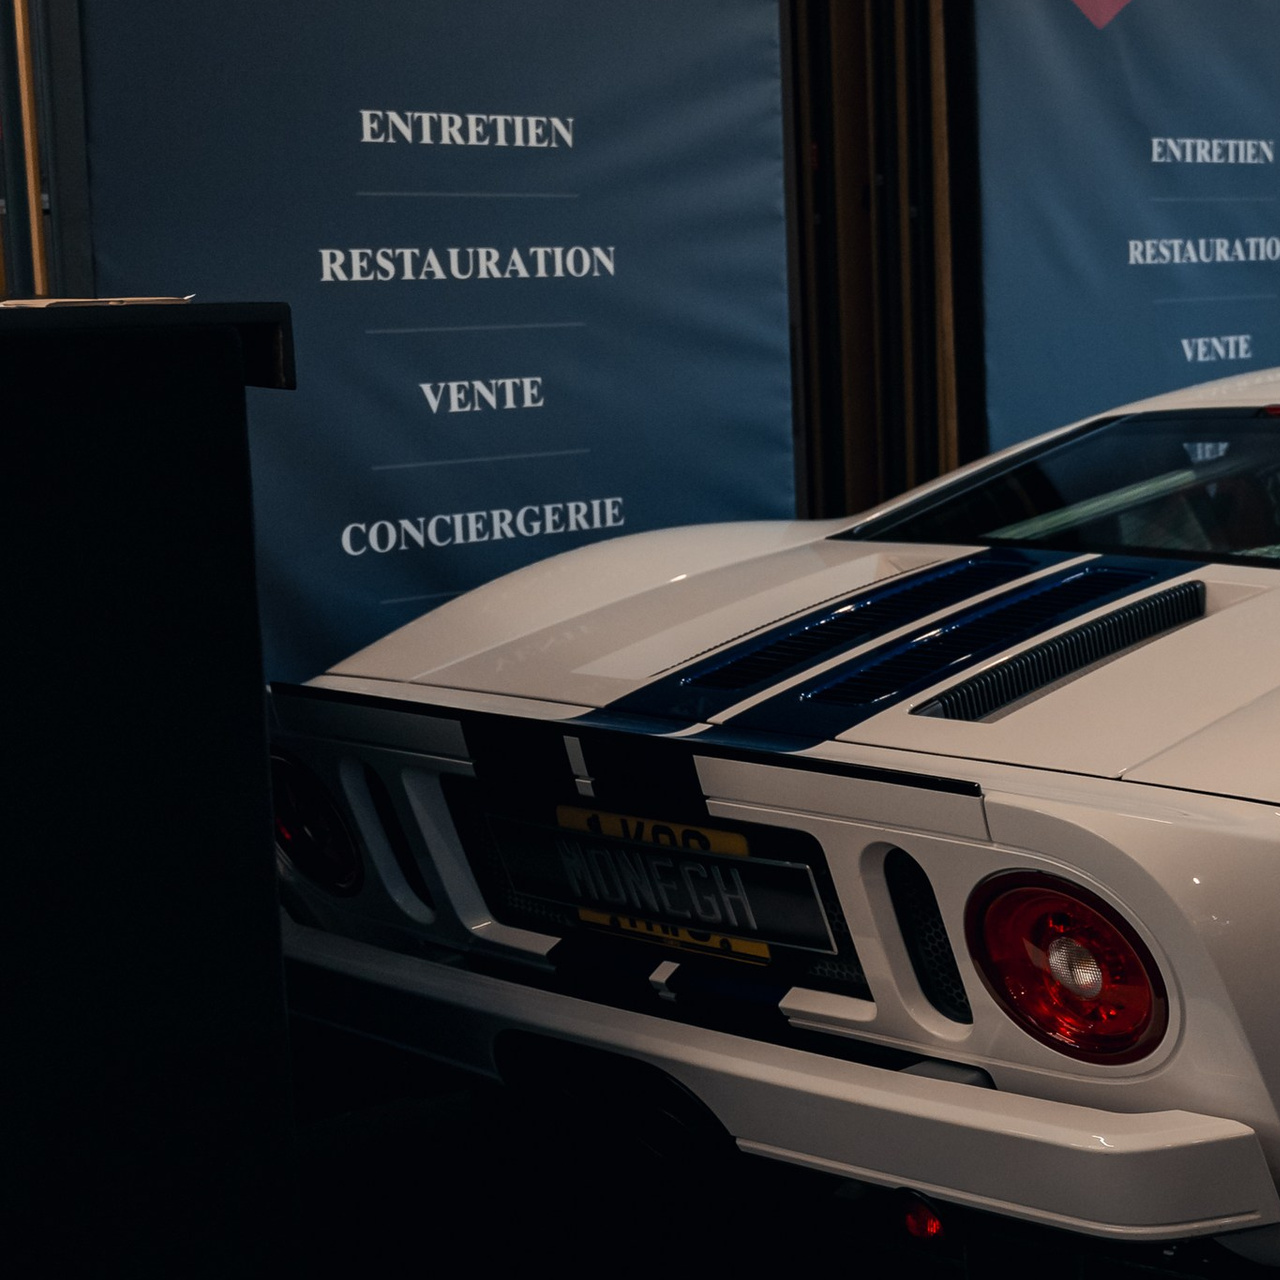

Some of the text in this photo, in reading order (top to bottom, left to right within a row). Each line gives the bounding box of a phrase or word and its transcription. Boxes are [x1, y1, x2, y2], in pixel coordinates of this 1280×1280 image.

[358, 108, 574, 148] ENTRETIEN
[1151, 137, 1274, 164] ENTRETIEN
[318, 245, 616, 282] RESTAURATION
[1180, 334, 1252, 362] VENTE
[419, 376, 545, 414] VENTE
[341, 496, 625, 557] CONCIERGERIE
[554, 838, 758, 931] MONEGH
